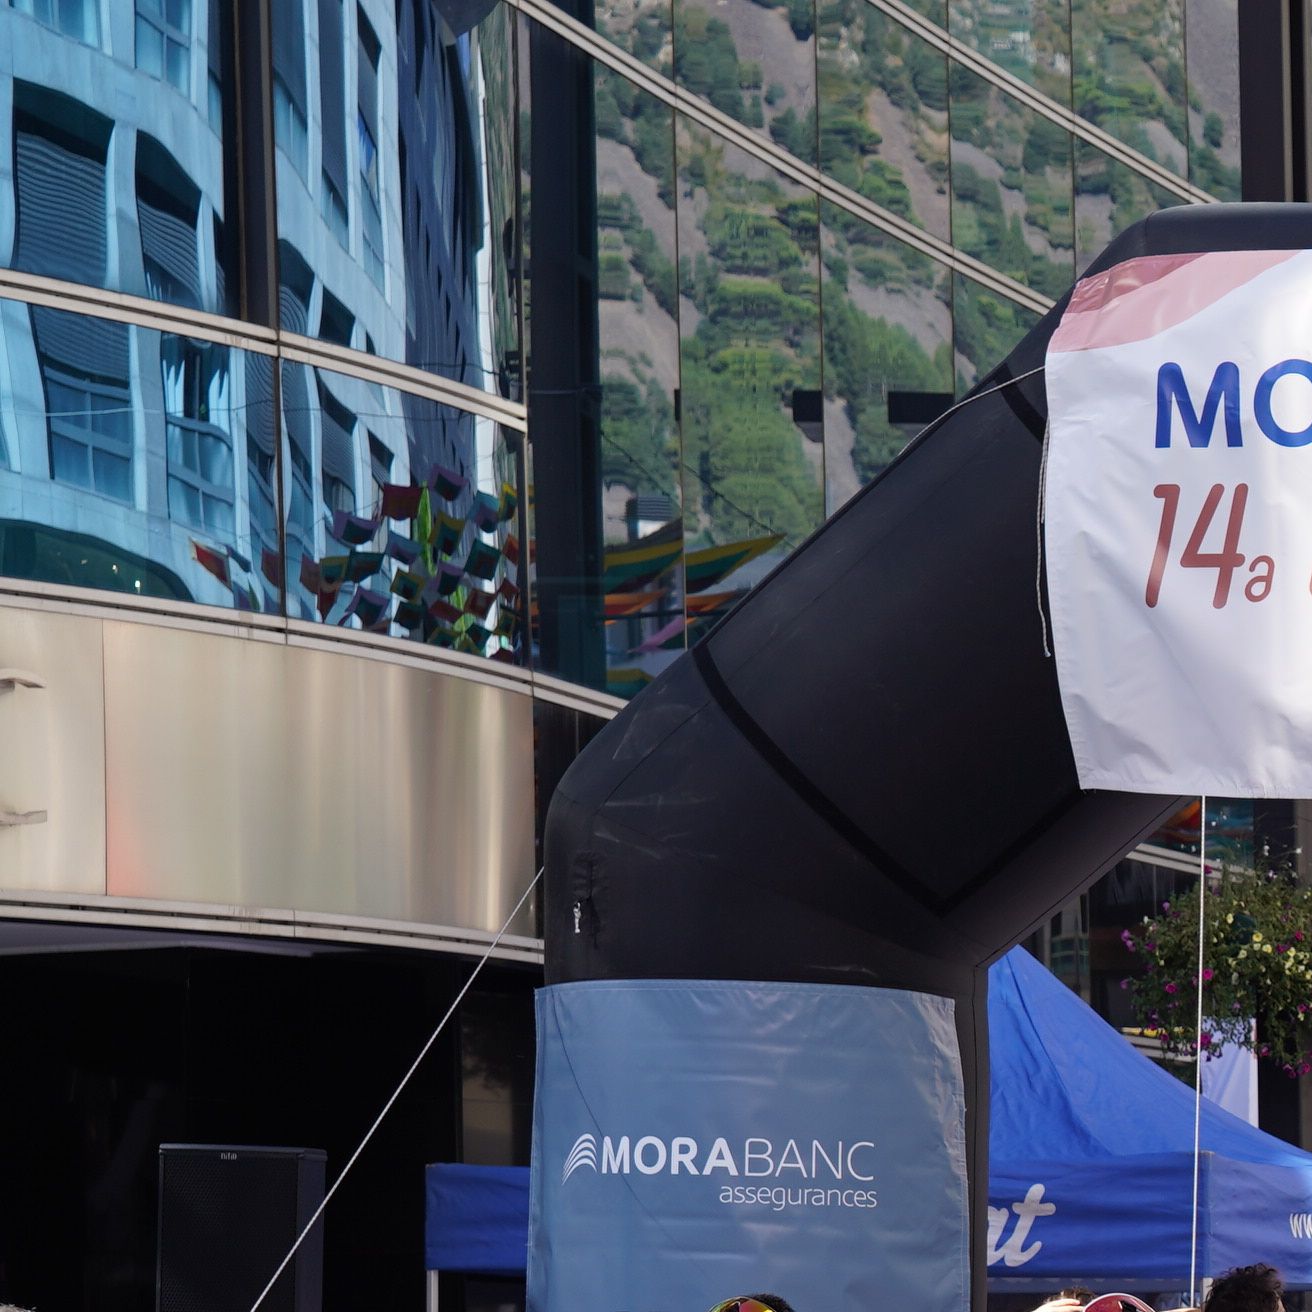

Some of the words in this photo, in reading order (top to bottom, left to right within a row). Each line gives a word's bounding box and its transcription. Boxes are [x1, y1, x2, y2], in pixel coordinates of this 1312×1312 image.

[1144, 482, 1274, 609] 14a
[601, 1136, 876, 1181] MORABANC
[719, 1183, 878, 1211] assegurances
